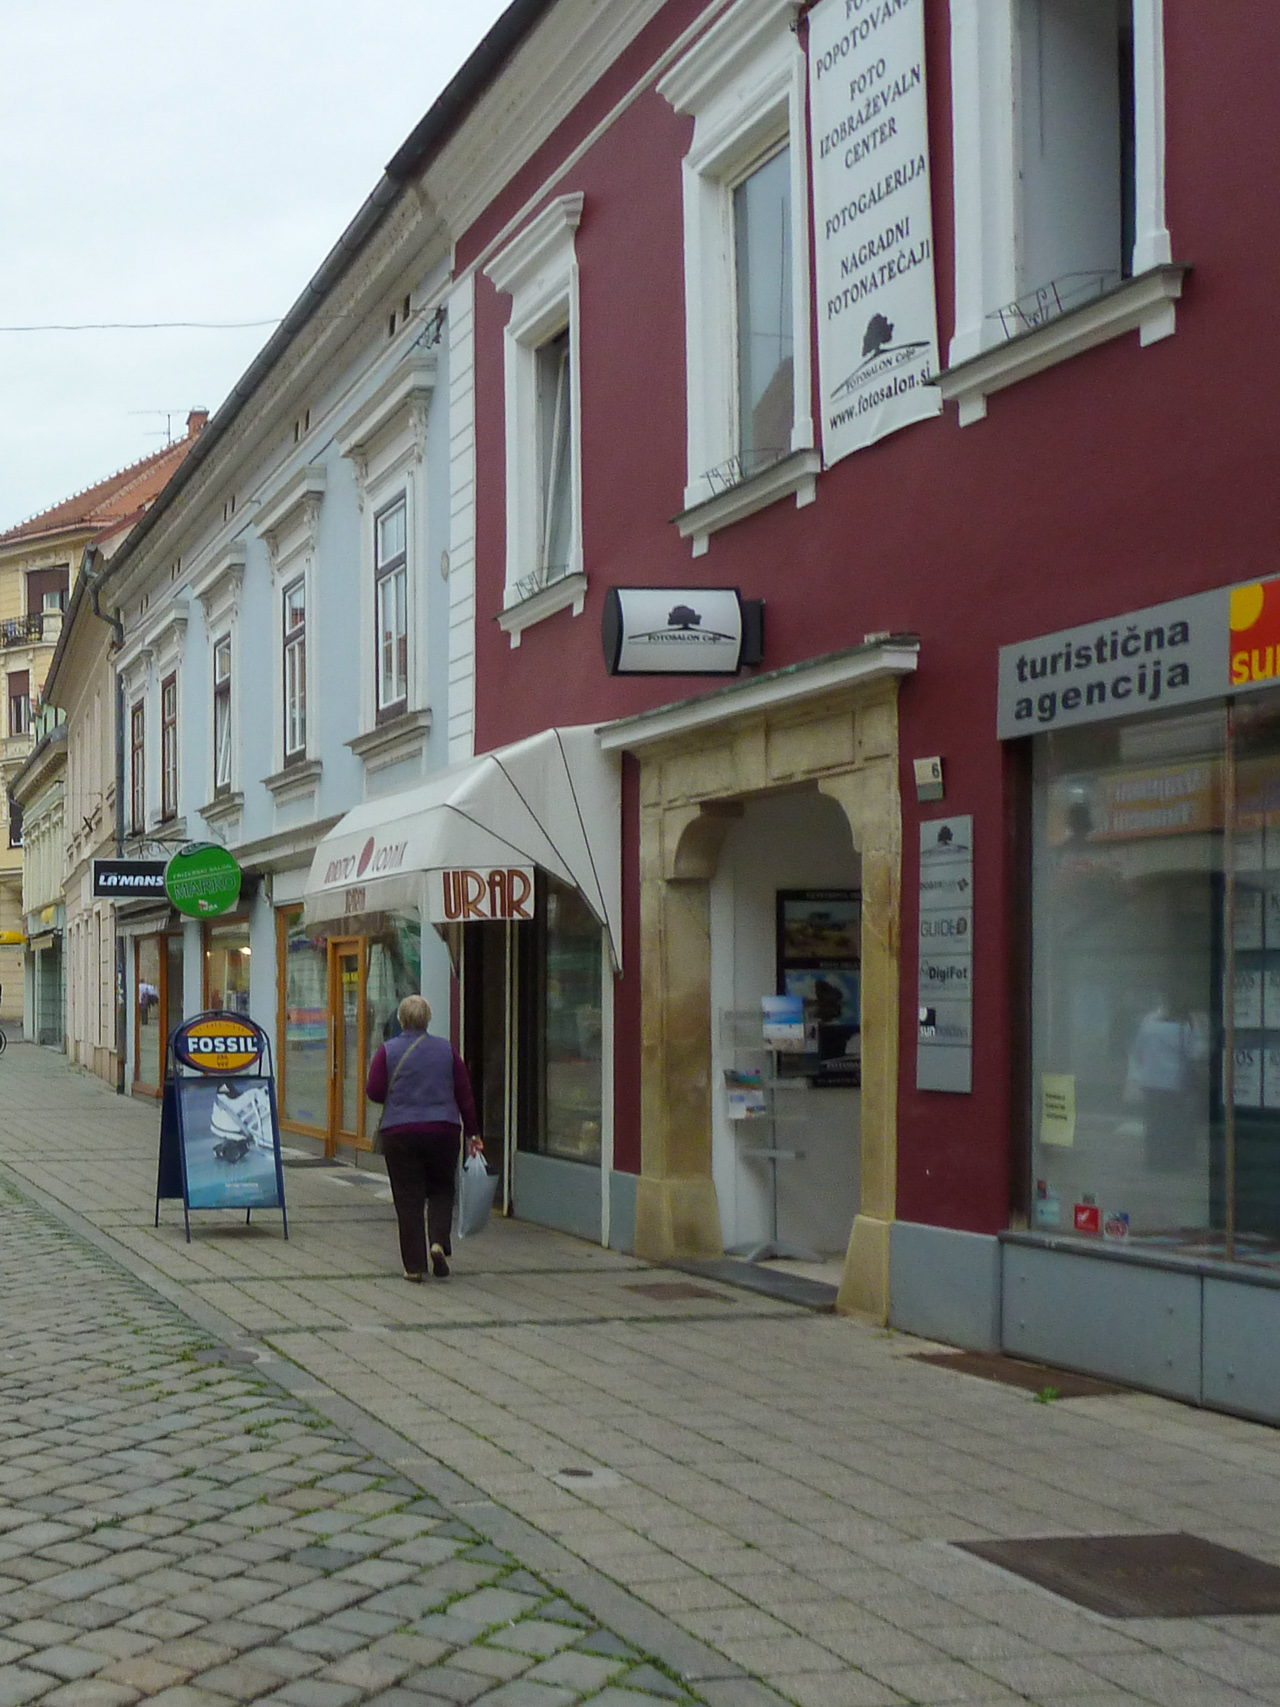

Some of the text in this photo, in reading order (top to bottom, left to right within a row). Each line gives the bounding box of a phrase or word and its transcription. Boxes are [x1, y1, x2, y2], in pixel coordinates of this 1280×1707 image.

[816, 0, 912, 80] POPOTOVAN
[849, 58, 886, 101] FOTO
[844, 116, 897, 169] CENTER
[825, 154, 926, 240] FOTOGALERIJA
[841, 216, 910, 279] NAGRADNI
[827, 238, 931, 320] FOTONATEČAJI
[829, 360, 931, 430] www.fotosalon.si
[1016, 620, 1189, 682] turistična
[1014, 660, 1190, 723] agencija
[931, 762, 940, 779] 6
[174, 874, 236, 900] MARKO
[442, 869, 532, 920] URAR
[187, 1036, 258, 1053] FOSSIL
